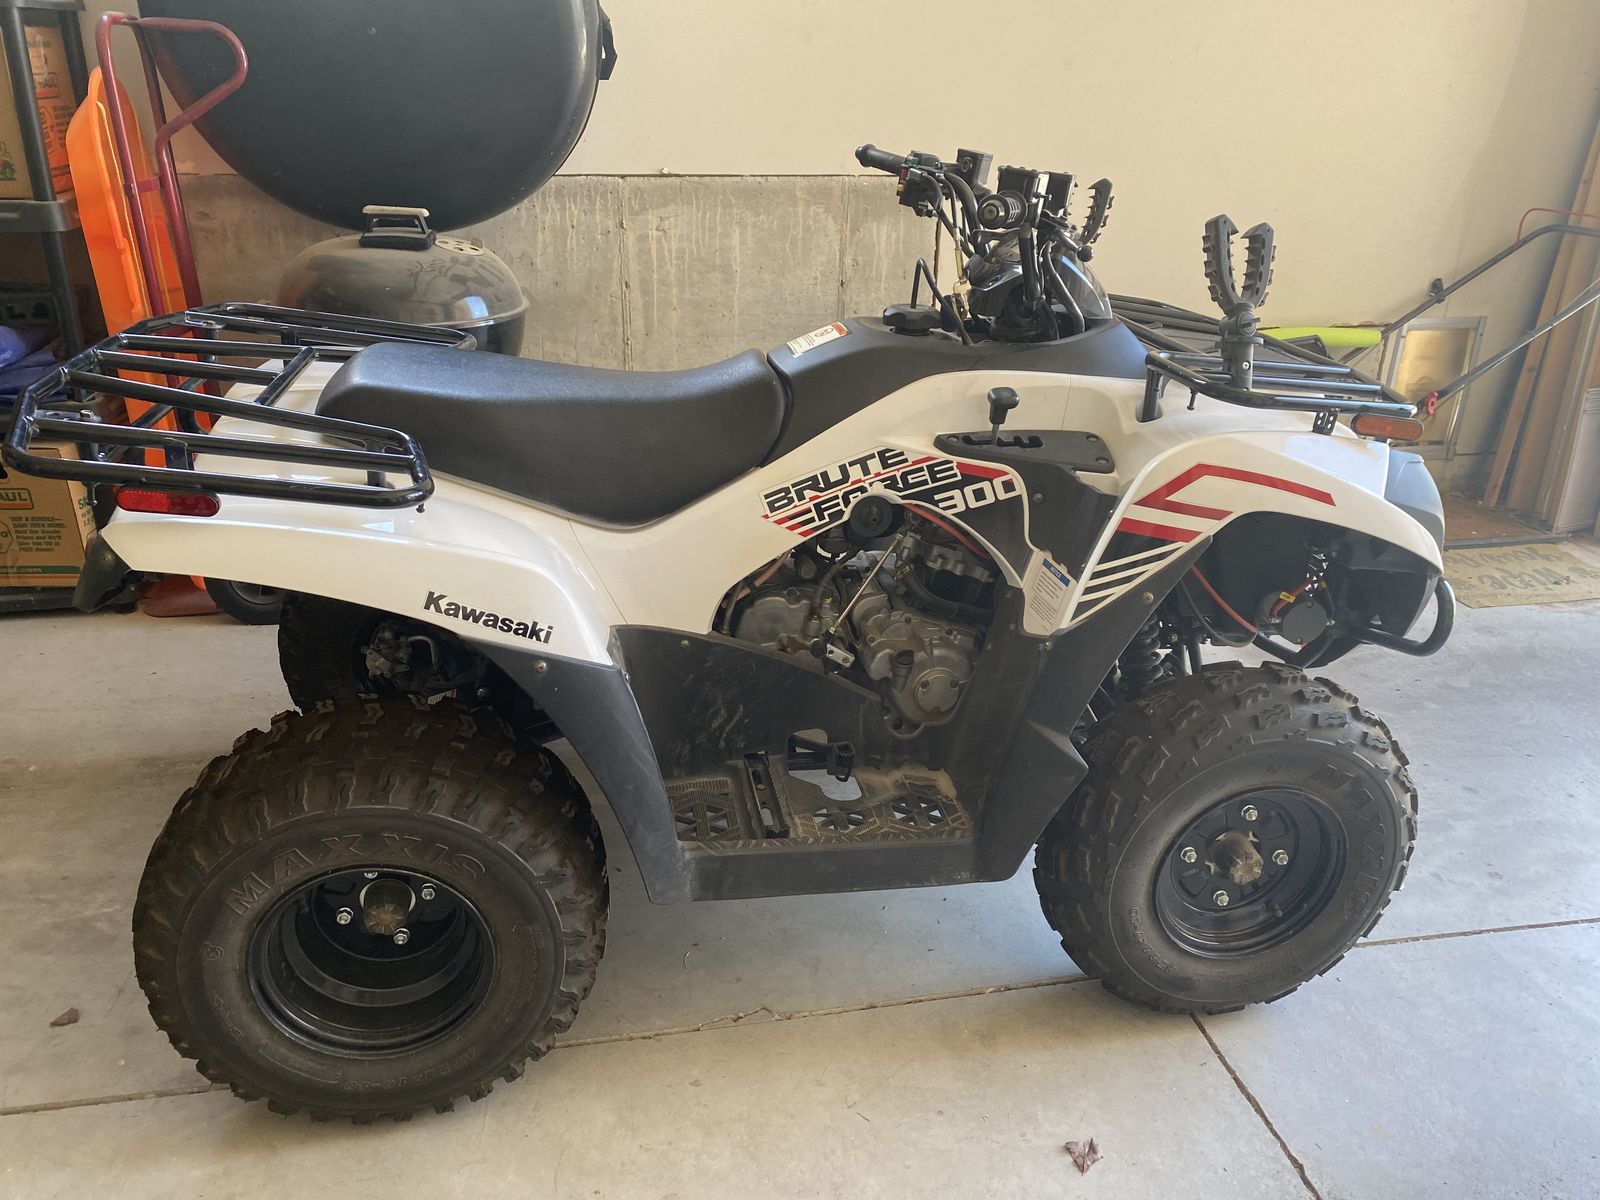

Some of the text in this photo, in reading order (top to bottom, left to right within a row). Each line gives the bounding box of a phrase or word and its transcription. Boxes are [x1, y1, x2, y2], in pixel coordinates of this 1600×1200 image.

[763, 447, 911, 514] BRUTE
[933, 474, 1022, 515] 300
[423, 590, 554, 645] Kawasaki
[225, 833, 487, 917] MAXXIS
